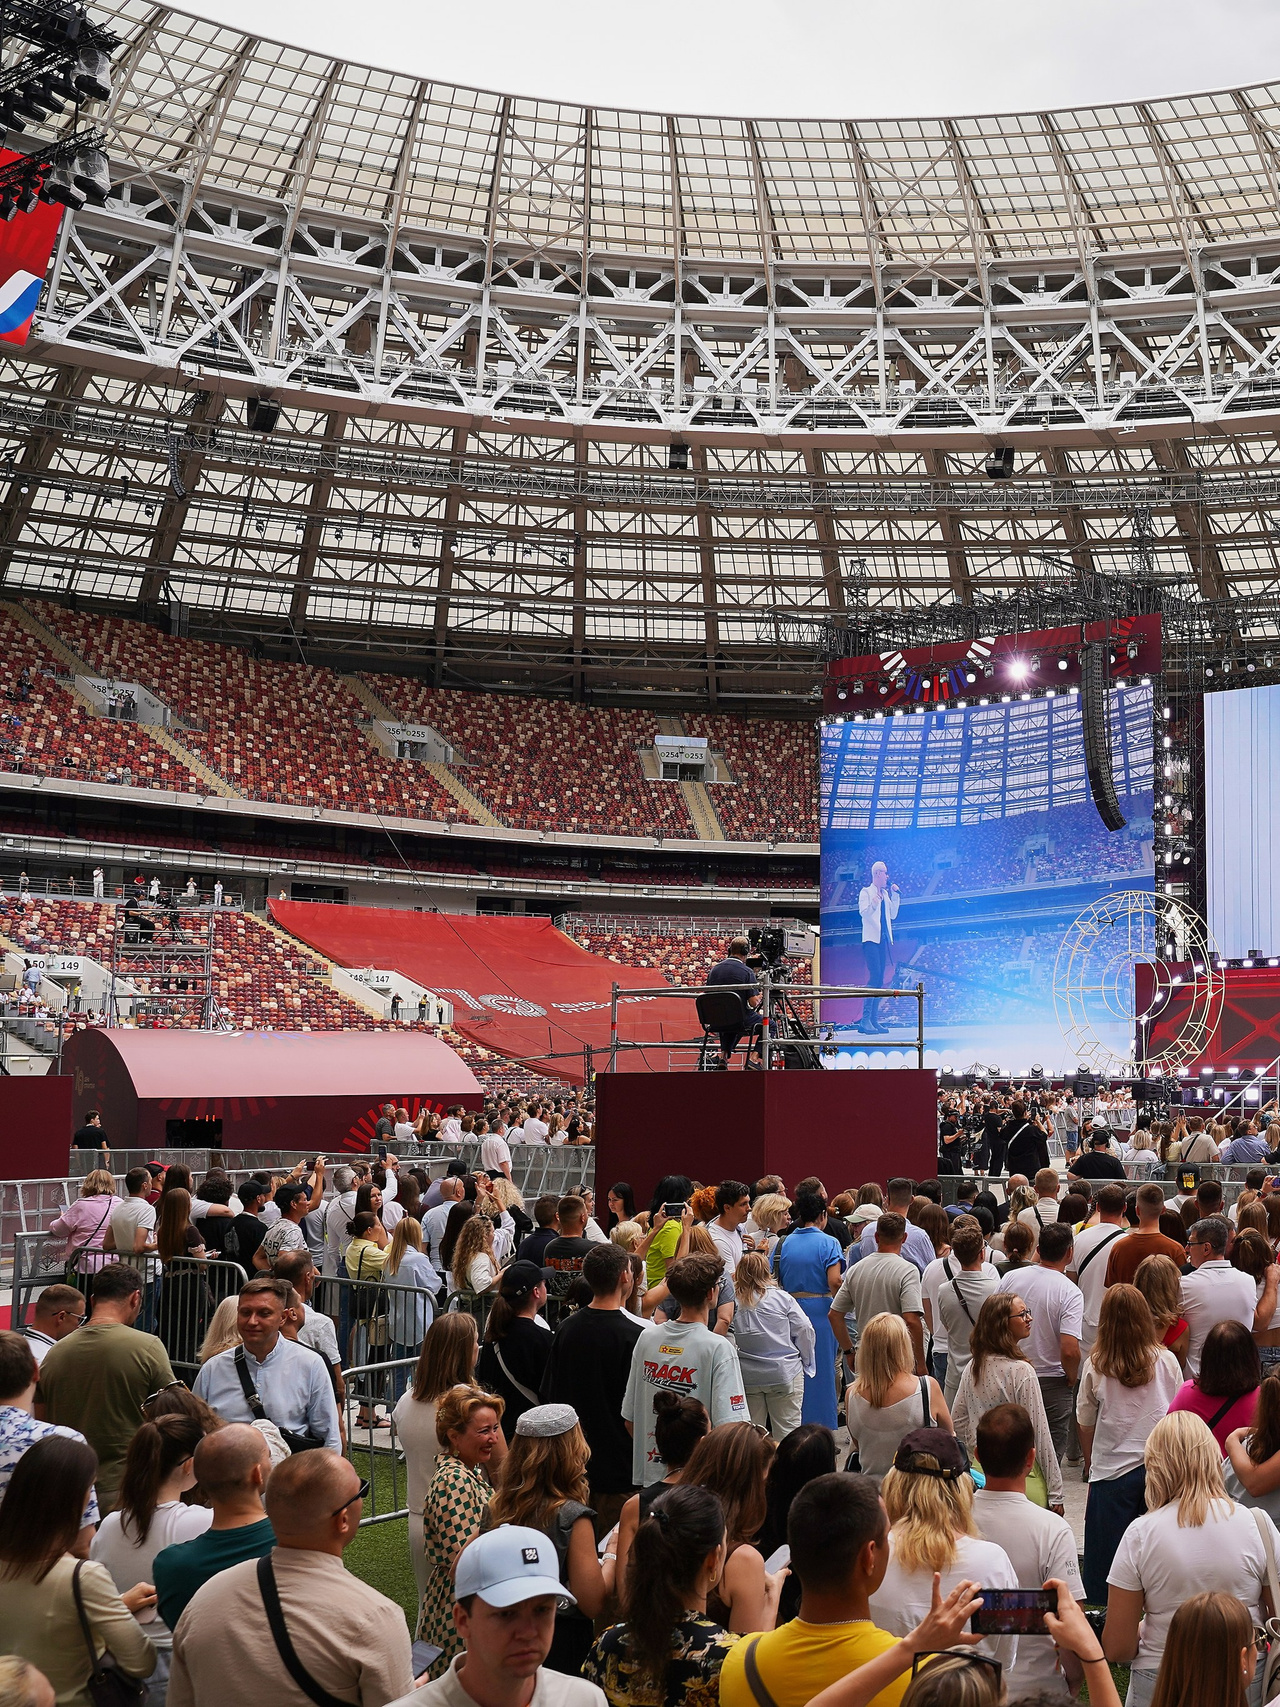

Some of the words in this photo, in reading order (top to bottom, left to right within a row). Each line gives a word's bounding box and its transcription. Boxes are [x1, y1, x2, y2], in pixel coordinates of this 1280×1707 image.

[666, 751, 680, 759] 254
[690, 752, 704, 760] 253
[61, 961, 79, 970] 149
[375, 975, 390, 983] 147
[643, 1360, 698, 1384] TRACK
